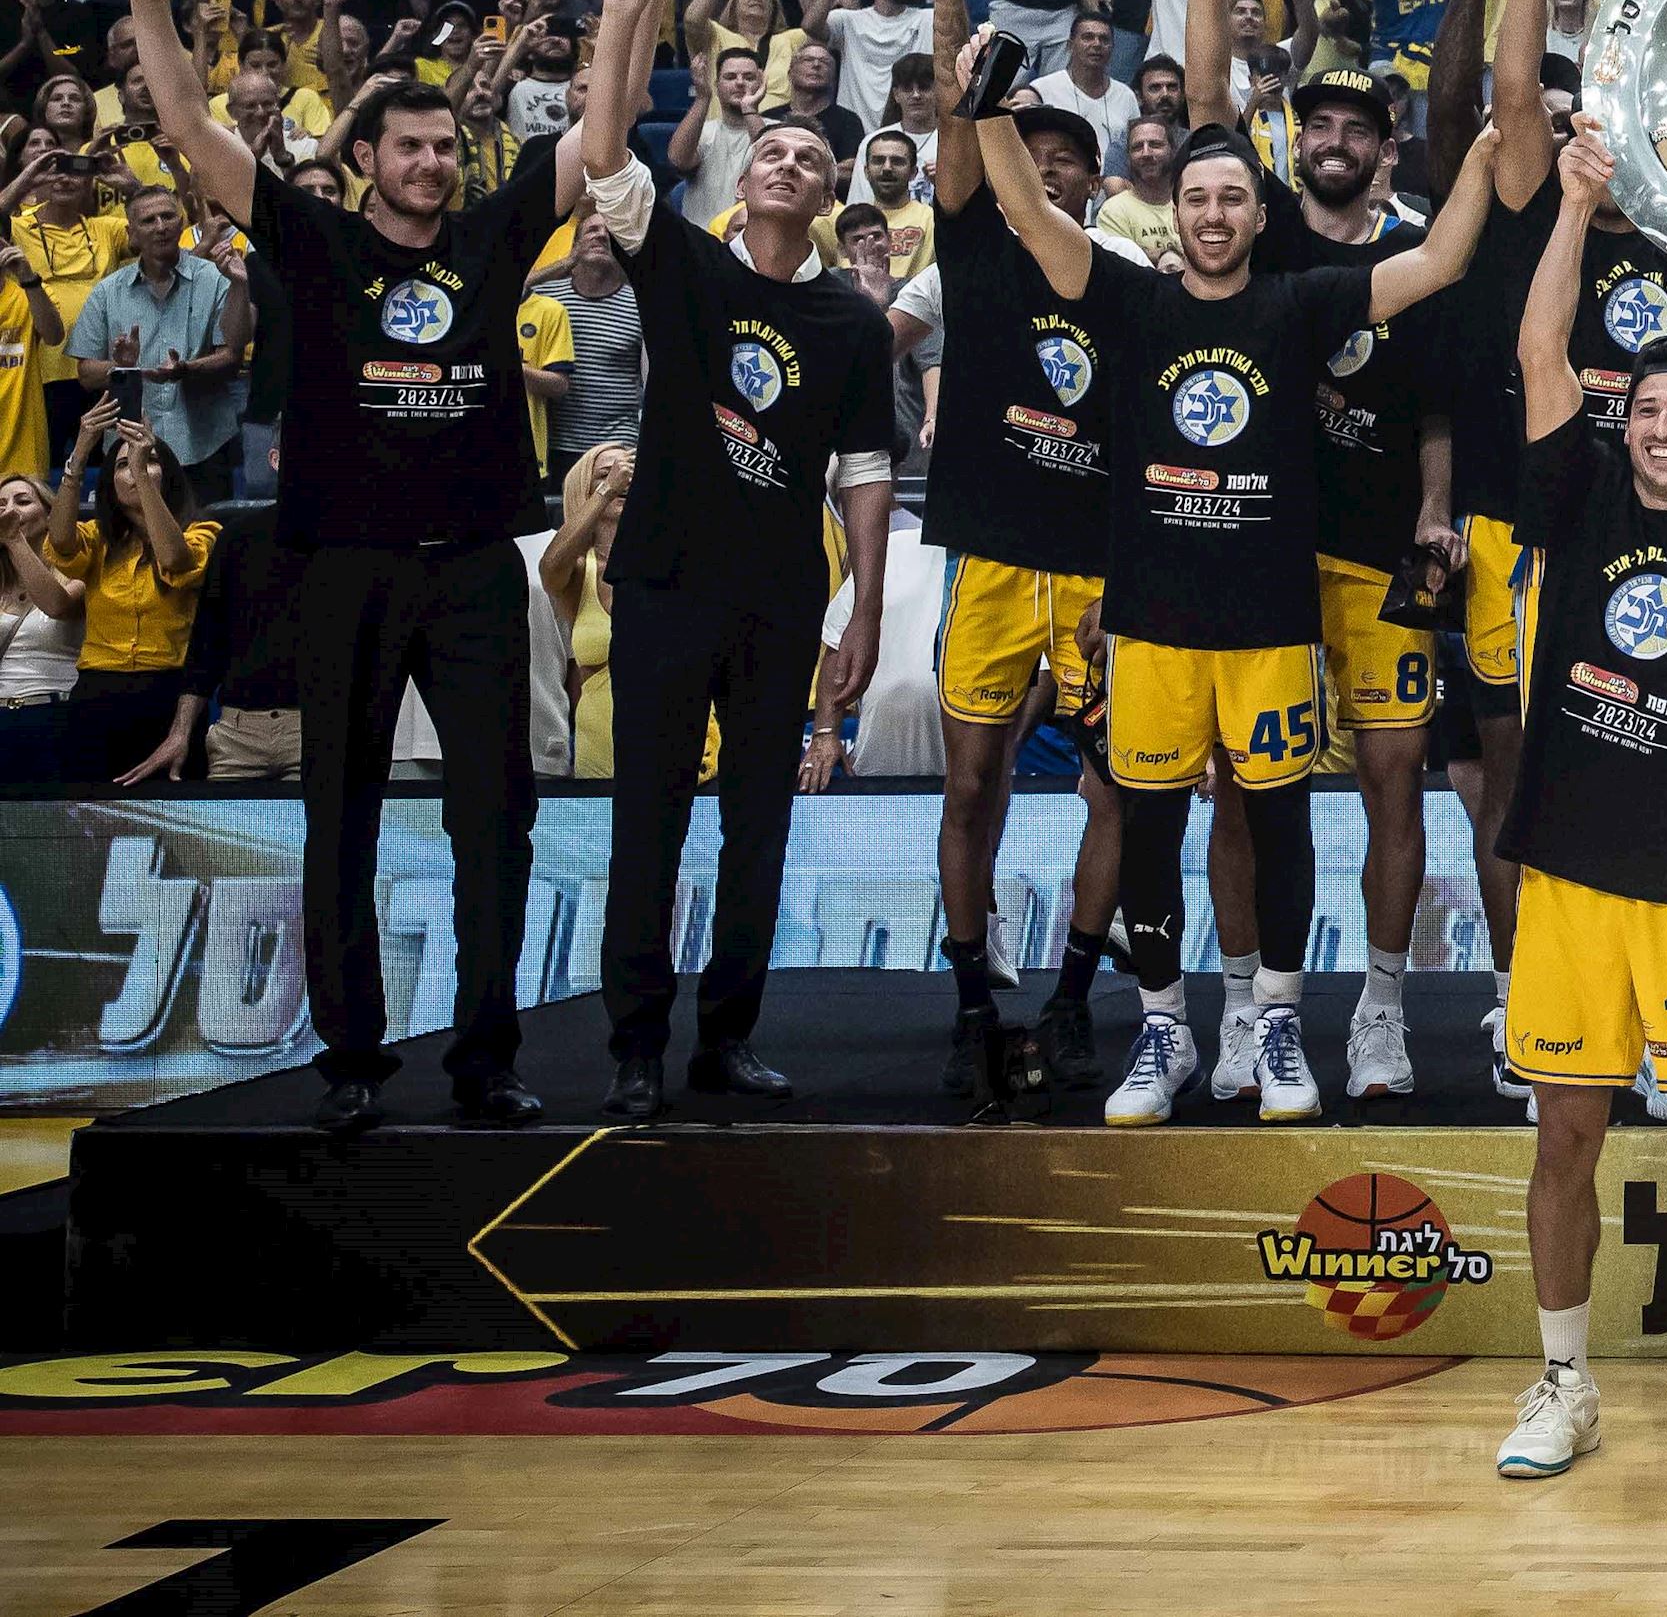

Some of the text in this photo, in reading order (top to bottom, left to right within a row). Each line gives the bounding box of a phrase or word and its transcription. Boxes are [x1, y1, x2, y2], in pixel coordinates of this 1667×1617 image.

[1321, 70, 1374, 93] CHAMP
[1158, 347, 1269, 397] מכבי PLAYTIKA תל-אביב
[397, 389, 464, 406] 2023/24
[1032, 435, 1094, 466] 2023/24
[1155, 470, 1198, 488] Winner
[1226, 472, 1269, 493] אלופת
[1174, 494, 1241, 516] 2023/24
[1396, 652, 1429, 704] 8
[1577, 667, 1624, 699] Winner
[979, 688, 1015, 702] Rapyd
[1595, 702, 1659, 741] 2023/24
[1248, 709, 1316, 764] 45
[1135, 747, 1180, 765] Rapyd
[1535, 1036, 1583, 1055] Rapyd
[1376, 1222, 1442, 1250] ליגת
[1262, 1233, 1489, 1281] Winner סל
